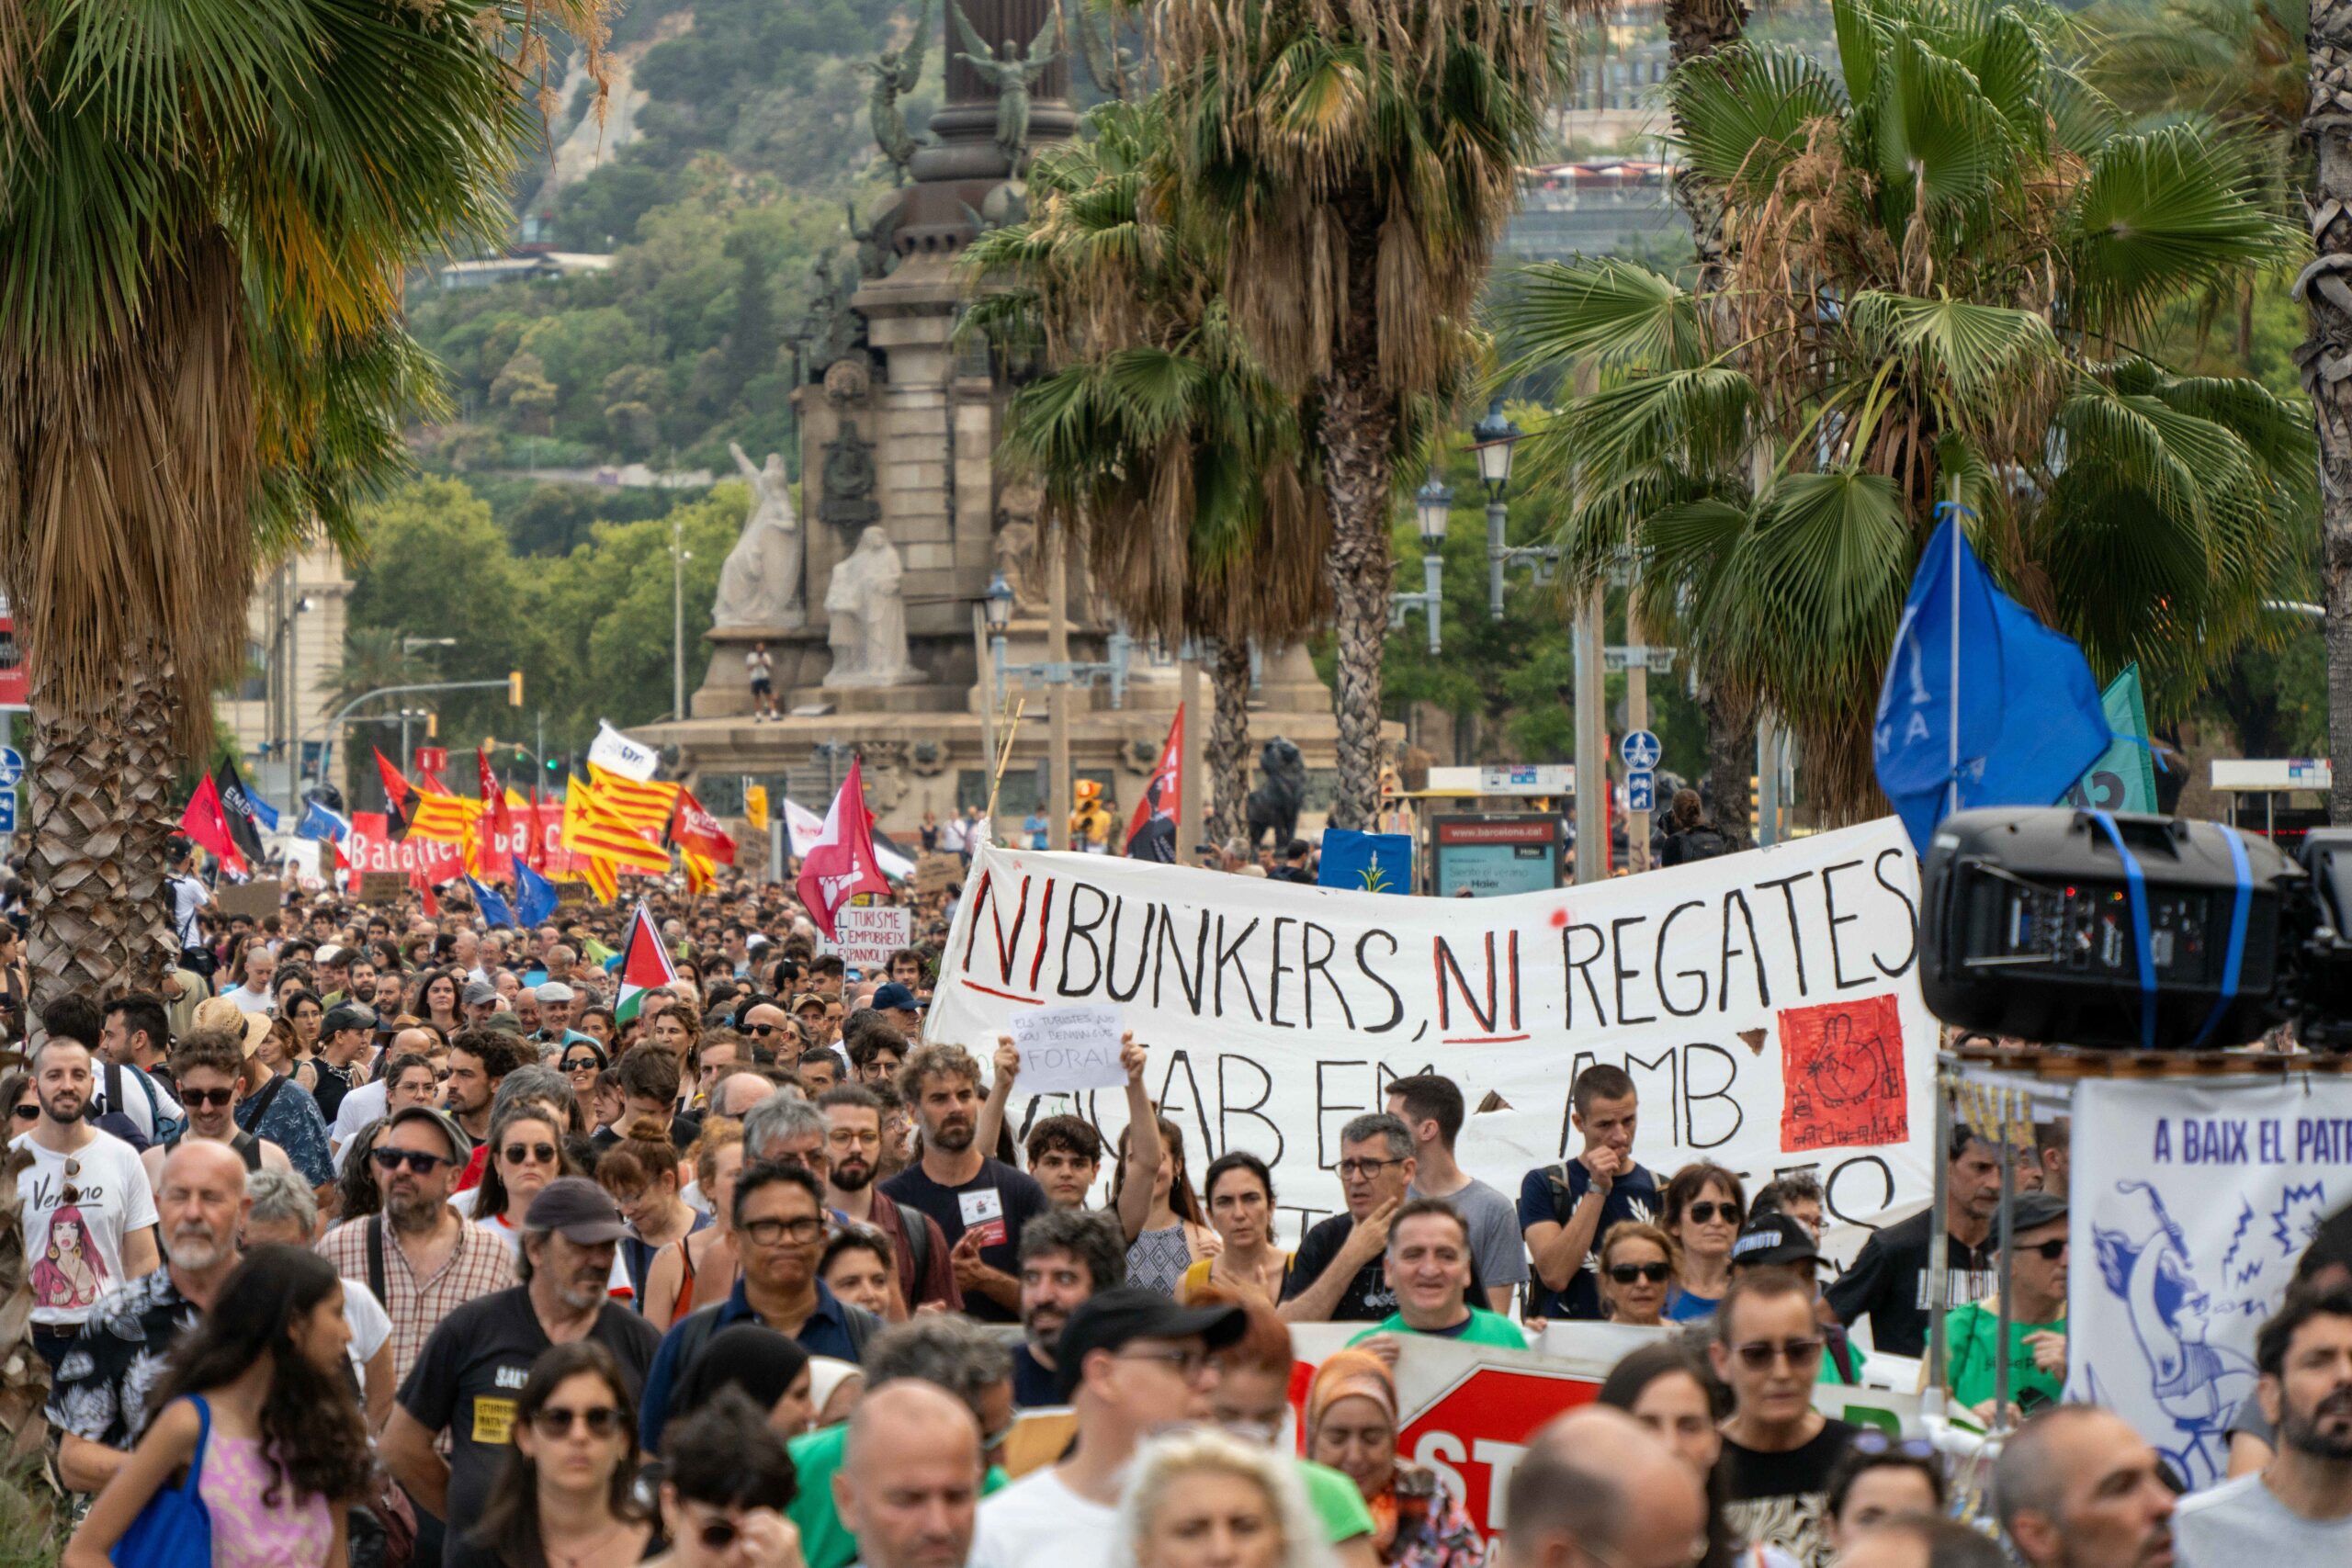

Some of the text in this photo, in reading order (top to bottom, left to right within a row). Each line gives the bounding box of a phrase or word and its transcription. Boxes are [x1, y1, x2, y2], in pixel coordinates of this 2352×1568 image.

[1452, 828, 1544, 838] www.barcelona.cat
[1471, 879, 1499, 888] Haier
[851, 911, 900, 929] TURISME
[963, 848, 1921, 1043] NI BUNKERS, NI REGATES
[1097, 1014, 1115, 1025] NO
[1559, 1043, 1744, 1160] AMB
[2154, 1119, 2172, 1164] A
[2183, 1119, 2249, 1165] BAIX
[2259, 1119, 2286, 1164] EL
[34, 1172, 103, 1212] Verno
